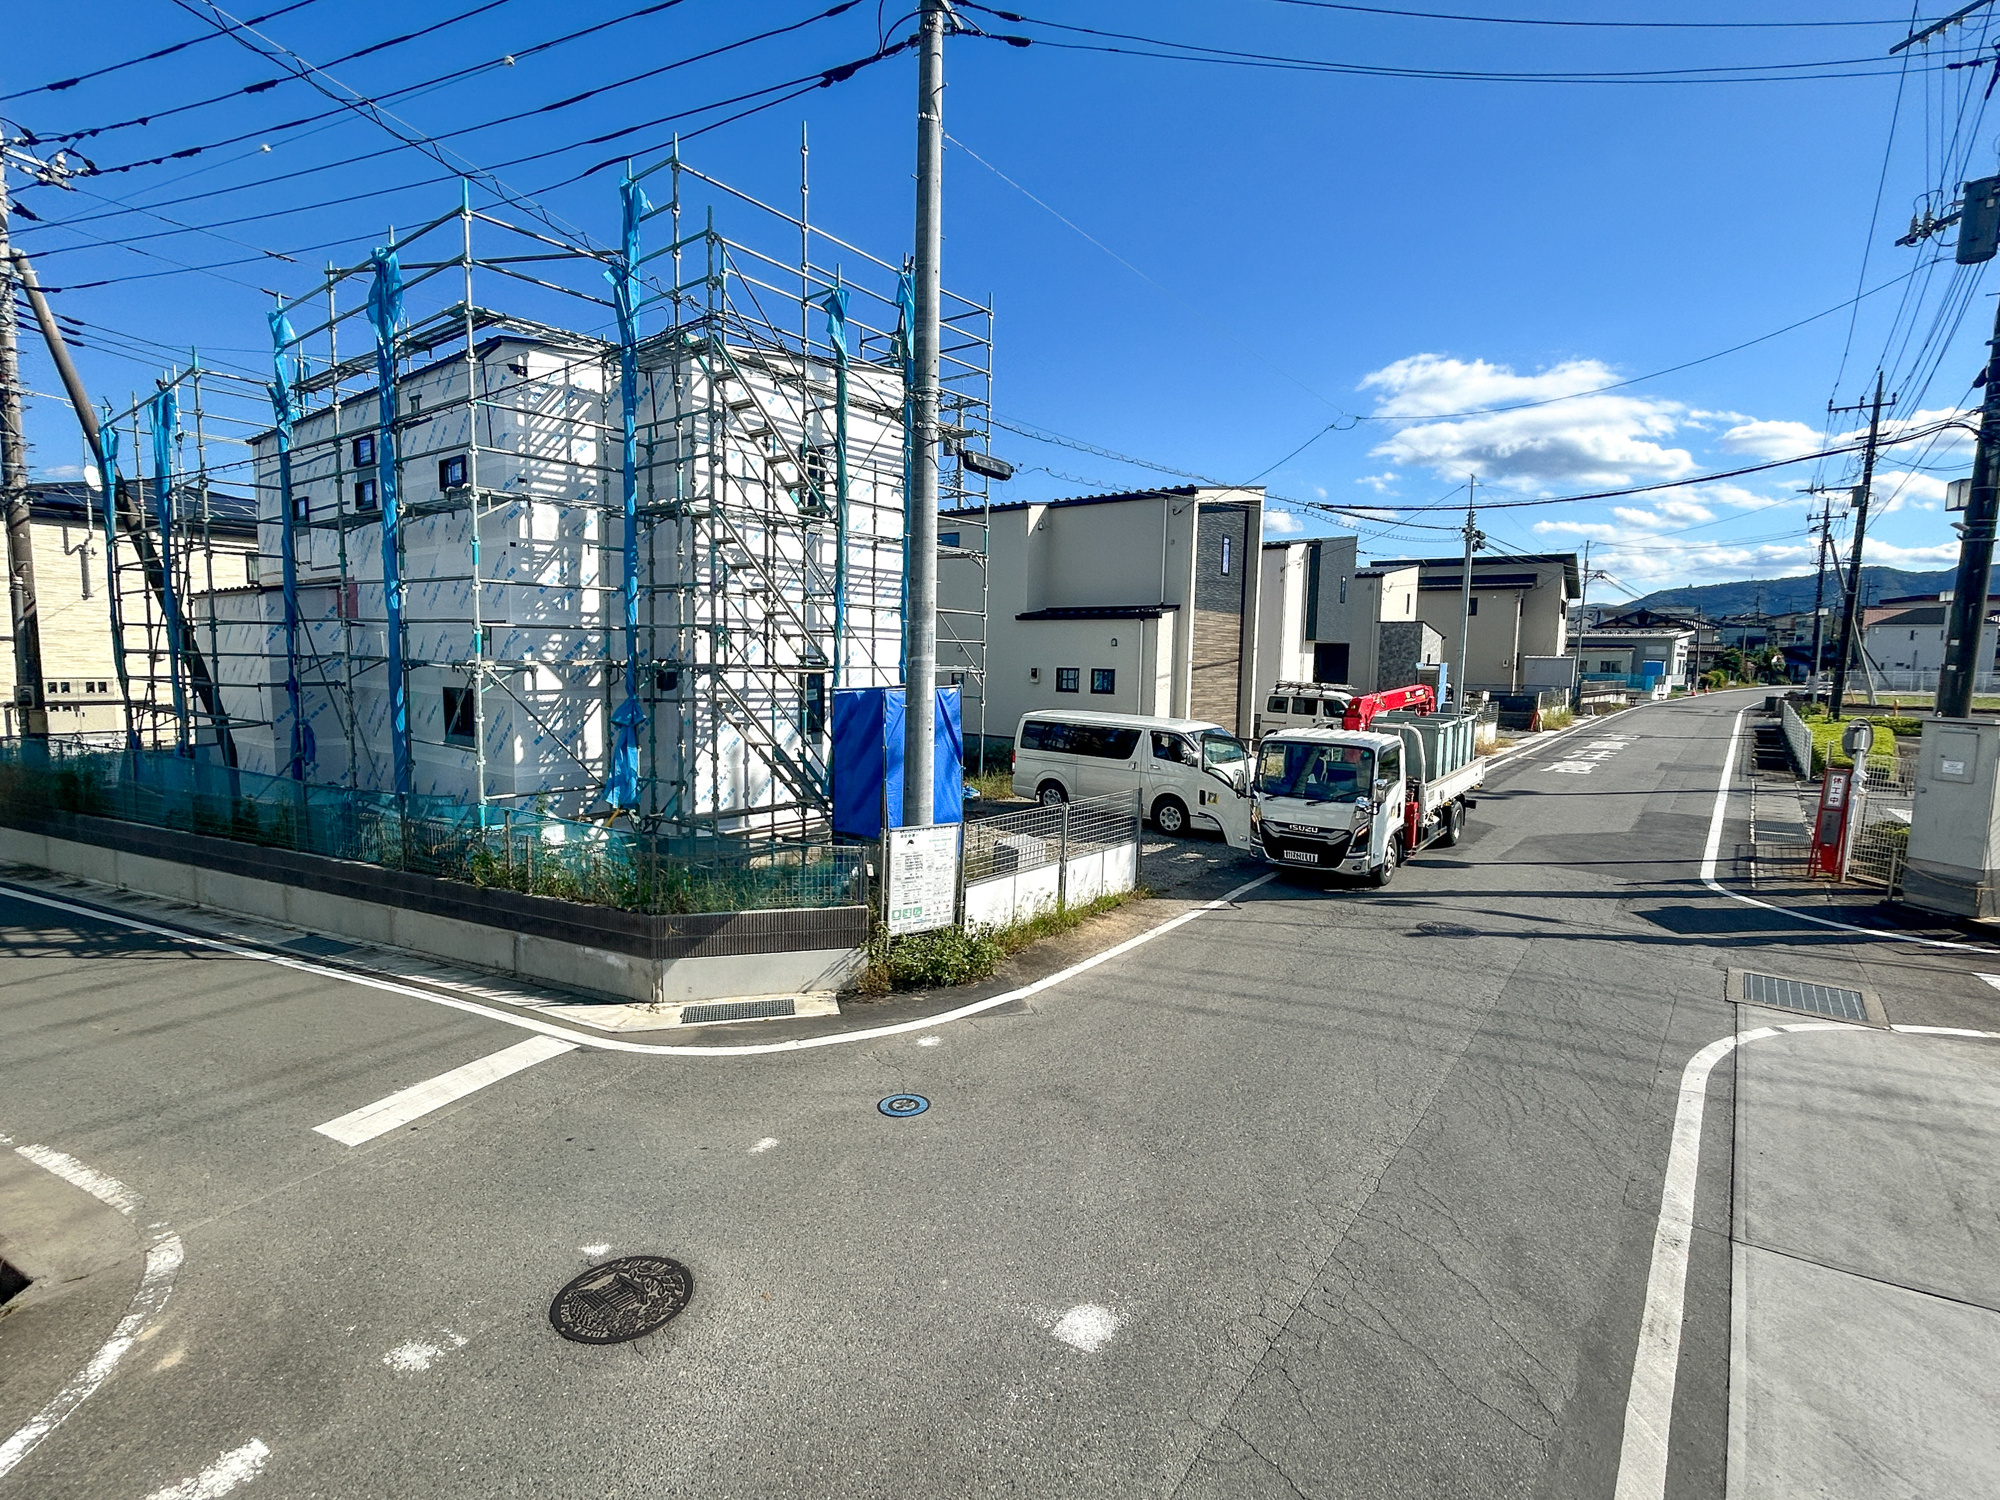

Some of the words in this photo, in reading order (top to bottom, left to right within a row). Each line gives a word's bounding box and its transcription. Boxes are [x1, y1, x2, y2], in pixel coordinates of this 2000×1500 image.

[1829, 777, 1843, 803] 休工中
[1289, 824, 1319, 833] ISUZU
